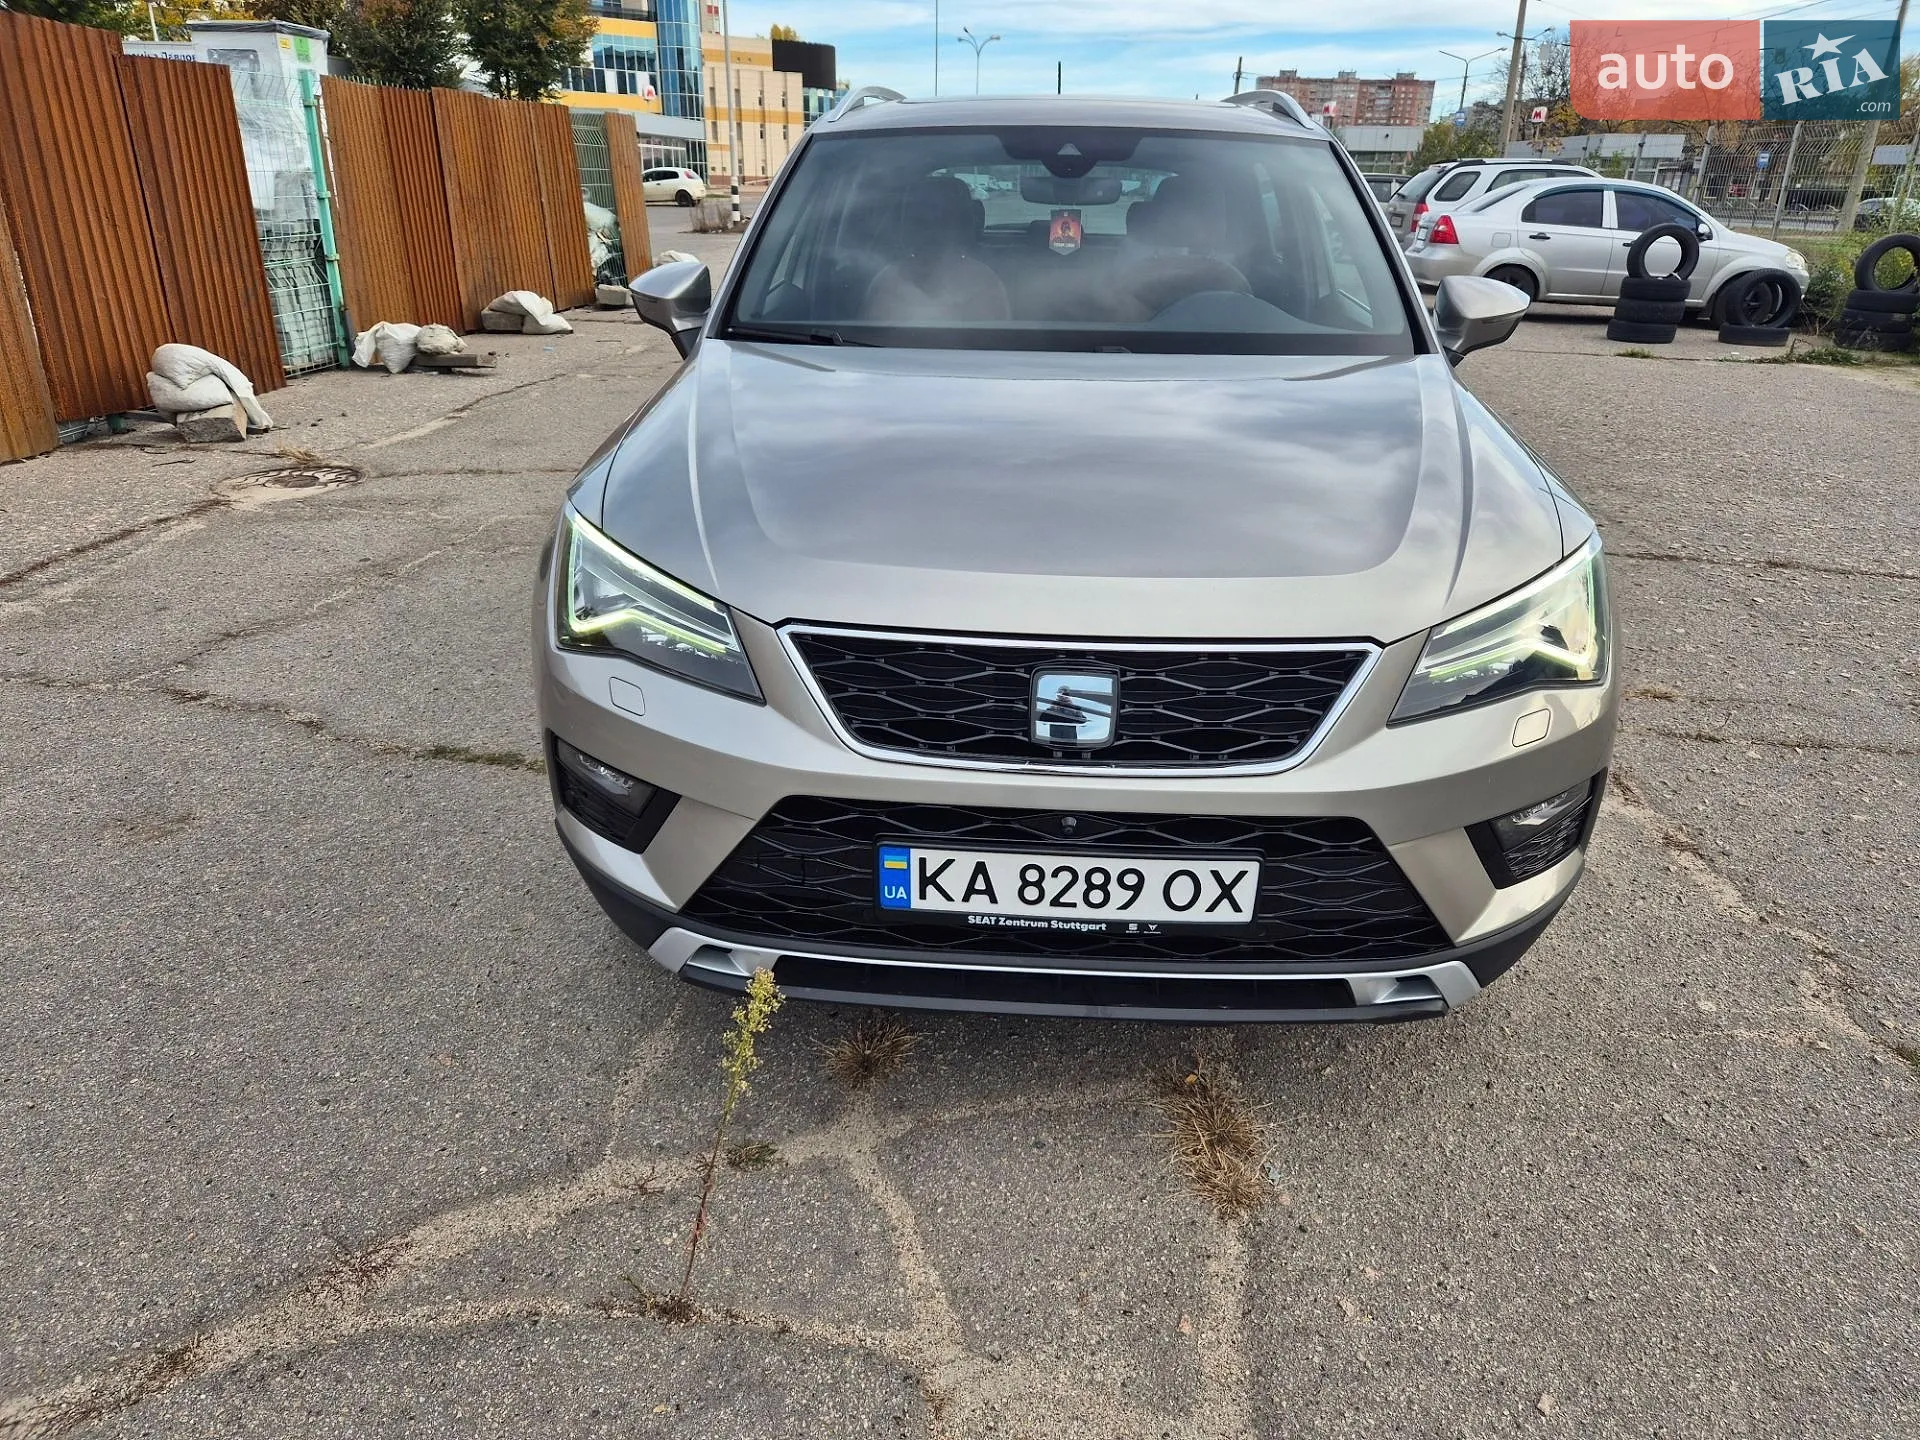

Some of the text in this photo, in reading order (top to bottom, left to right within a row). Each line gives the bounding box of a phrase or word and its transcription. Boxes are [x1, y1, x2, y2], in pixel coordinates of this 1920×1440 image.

[885, 886, 907, 900] UA
[918, 857, 1249, 914] KA 8289 OX
[967, 915, 1107, 931] SEAT Zentrum Stuttgart
